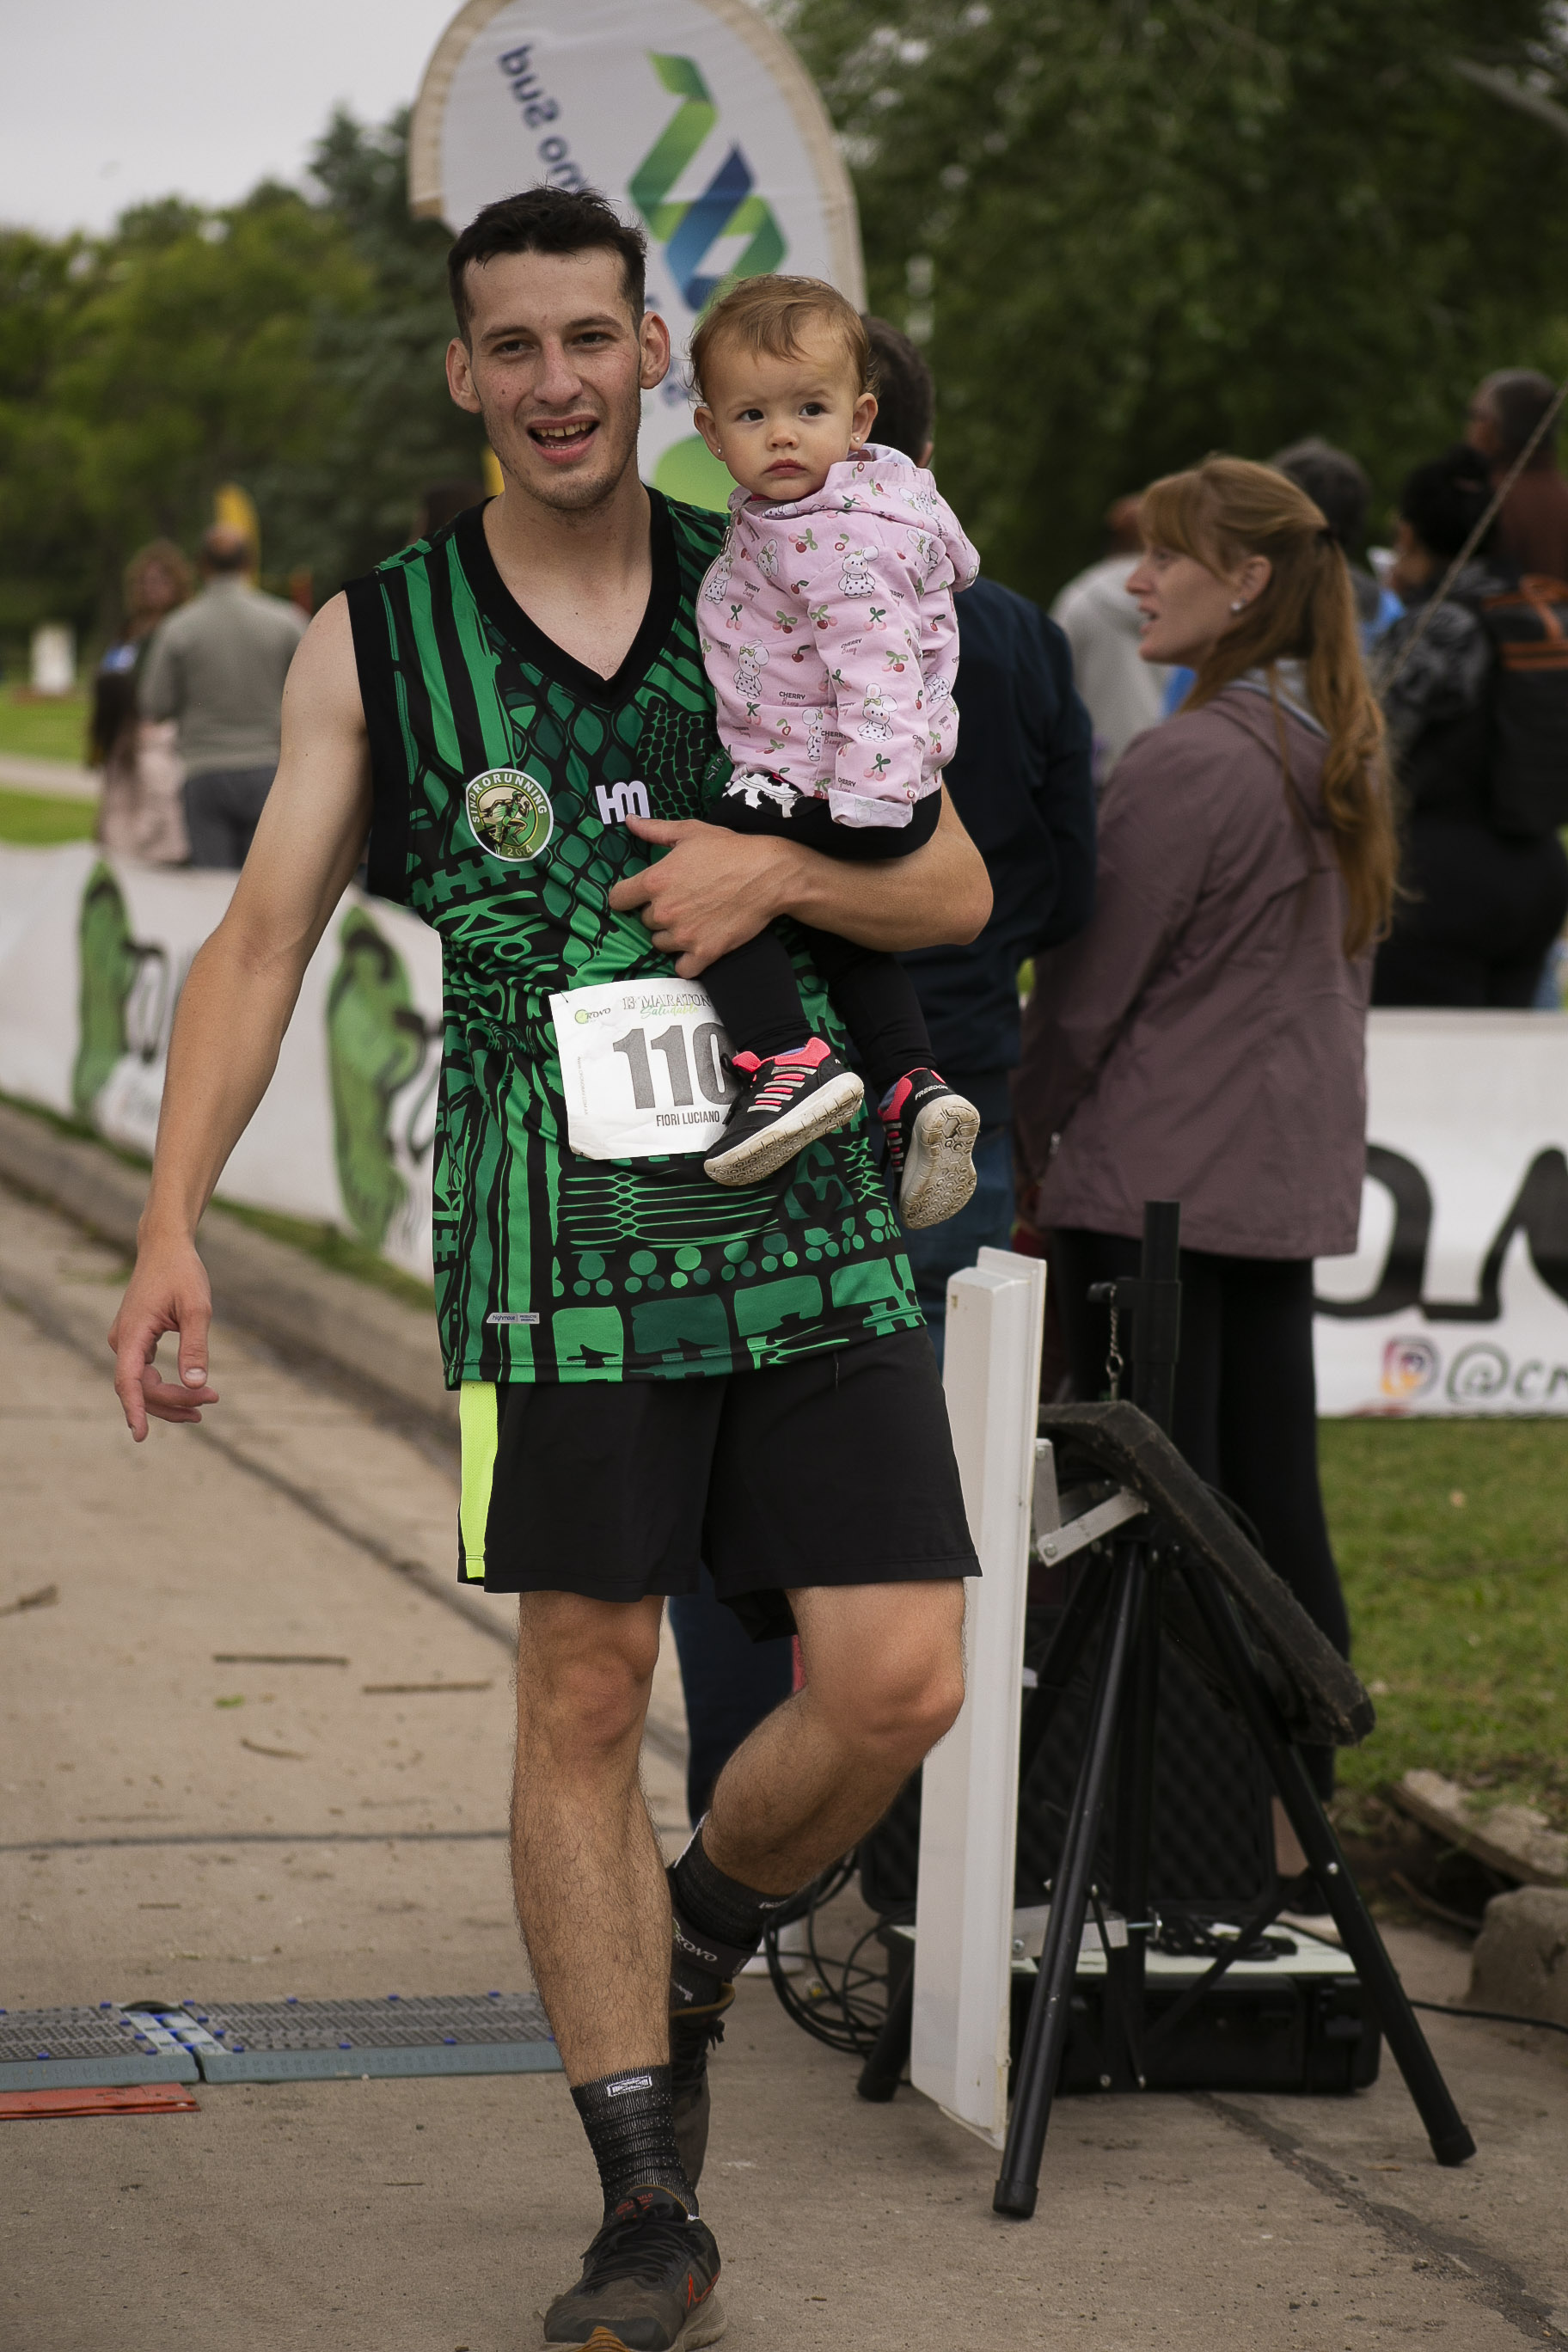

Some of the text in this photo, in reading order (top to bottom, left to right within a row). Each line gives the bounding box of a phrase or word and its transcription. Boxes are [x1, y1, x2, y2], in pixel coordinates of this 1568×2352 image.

[744, 580, 761, 593] CHERRY
[841, 638, 862, 649] CHERRY
[779, 691, 806, 701] CHERRY
[821, 730, 848, 739] CHERRY
[838, 776, 856, 787] CHERRY
[469, 773, 548, 824] SINDRORUNNING
[613, 1022, 738, 1110] 110
[915, 1084, 949, 1101] FREEDOM
[656, 1110, 720, 1127] FIORI LUCIANO
